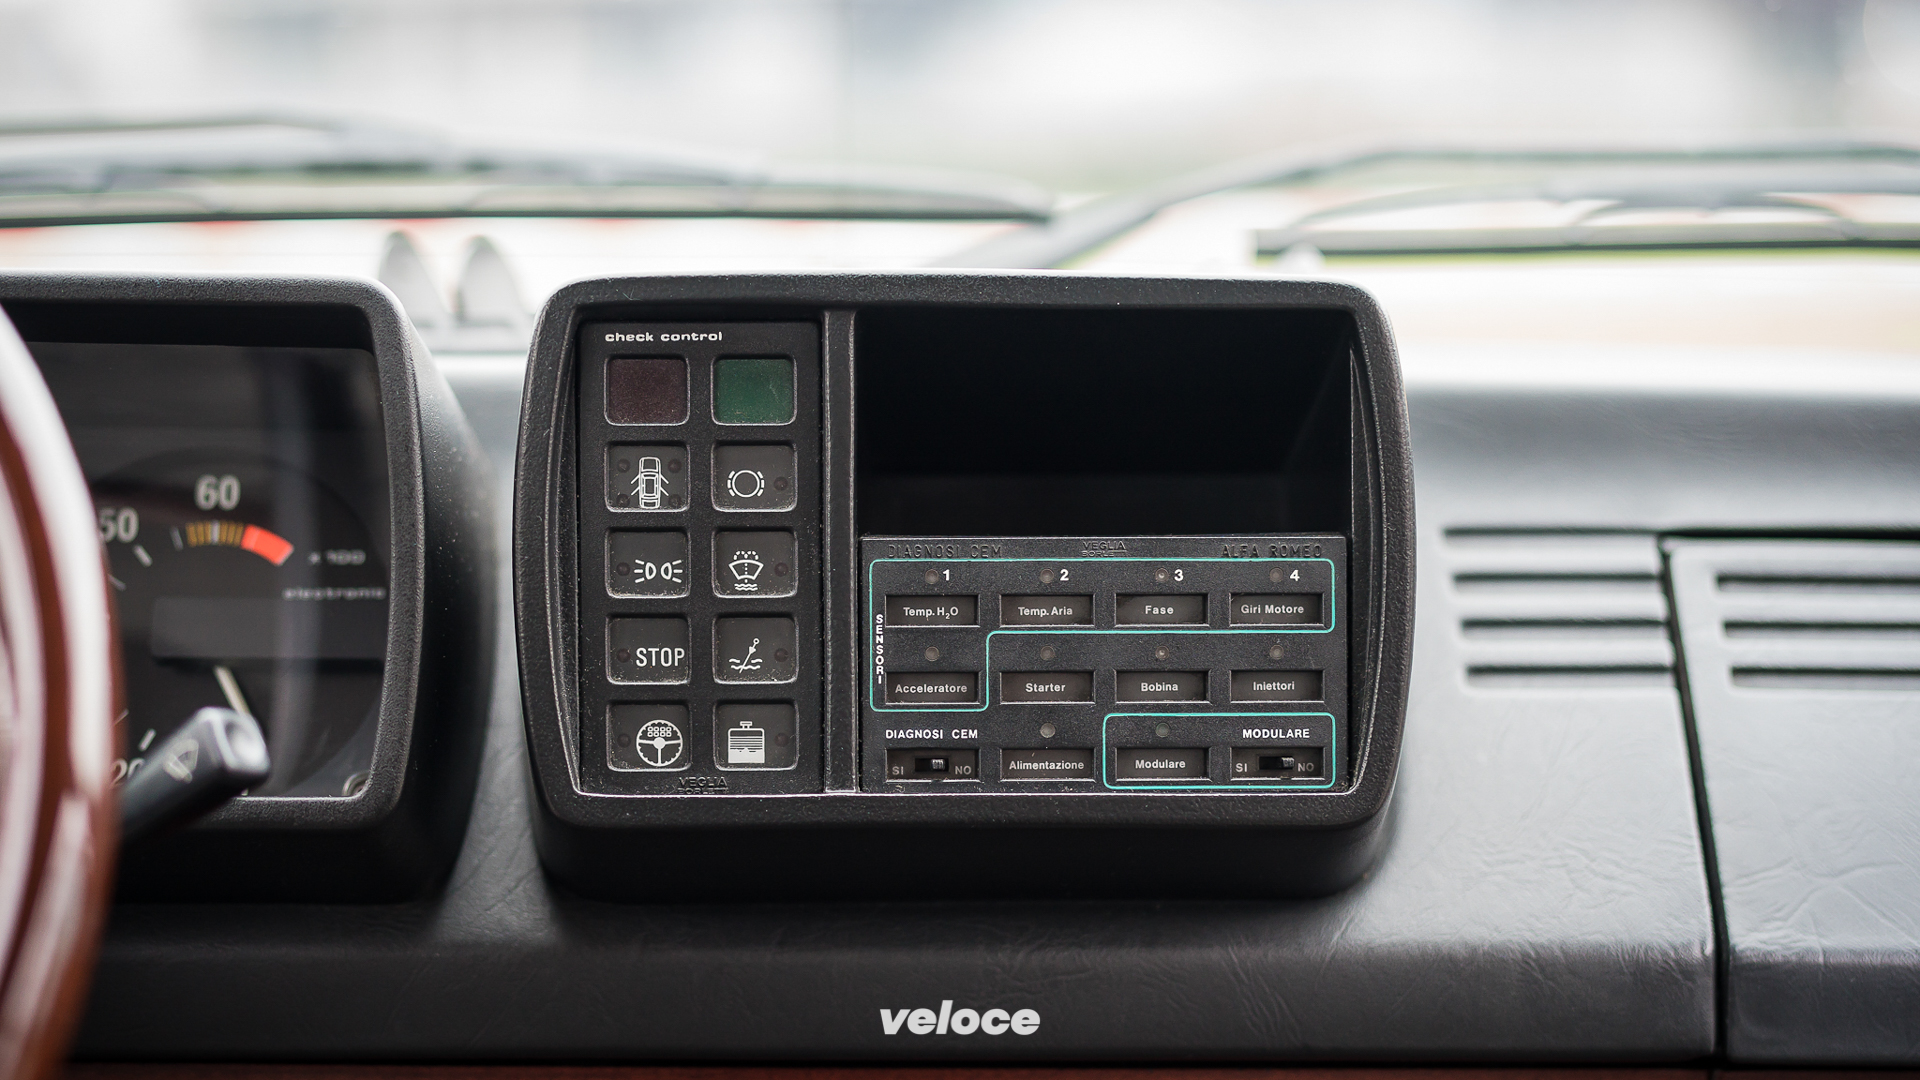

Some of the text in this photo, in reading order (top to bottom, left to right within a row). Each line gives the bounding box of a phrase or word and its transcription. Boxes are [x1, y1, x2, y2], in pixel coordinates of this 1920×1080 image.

[605, 331, 723, 342] check control
[195, 475, 241, 511] 60
[99, 506, 140, 543] 50
[1082, 540, 1127, 550] VEGLIA
[888, 544, 1002, 558] DIAGNOSI CEM
[1221, 544, 1322, 558] ALFA ROMEO
[942, 569, 951, 582] 1
[1059, 568, 1070, 582] 2
[1174, 568, 1184, 582] 3
[1289, 569, 1300, 582] 4
[1144, 605, 1174, 616] Fase
[1240, 604, 1304, 615] Giri Motore
[875, 614, 885, 685] SENSORI
[635, 647, 686, 668] STOP
[895, 684, 968, 694] Acceleratore
[1025, 682, 1066, 693] Starter
[1140, 682, 1179, 692] Bobina
[1252, 681, 1296, 691] Iniettori
[885, 729, 979, 740] DIAGNOSI CEM
[1242, 728, 1311, 740] MODULARE
[1008, 760, 1086, 771] Alimentazione
[1135, 759, 1186, 770] Modulare
[1235, 762, 1316, 773] SI NO
[891, 766, 973, 776] SI NO
